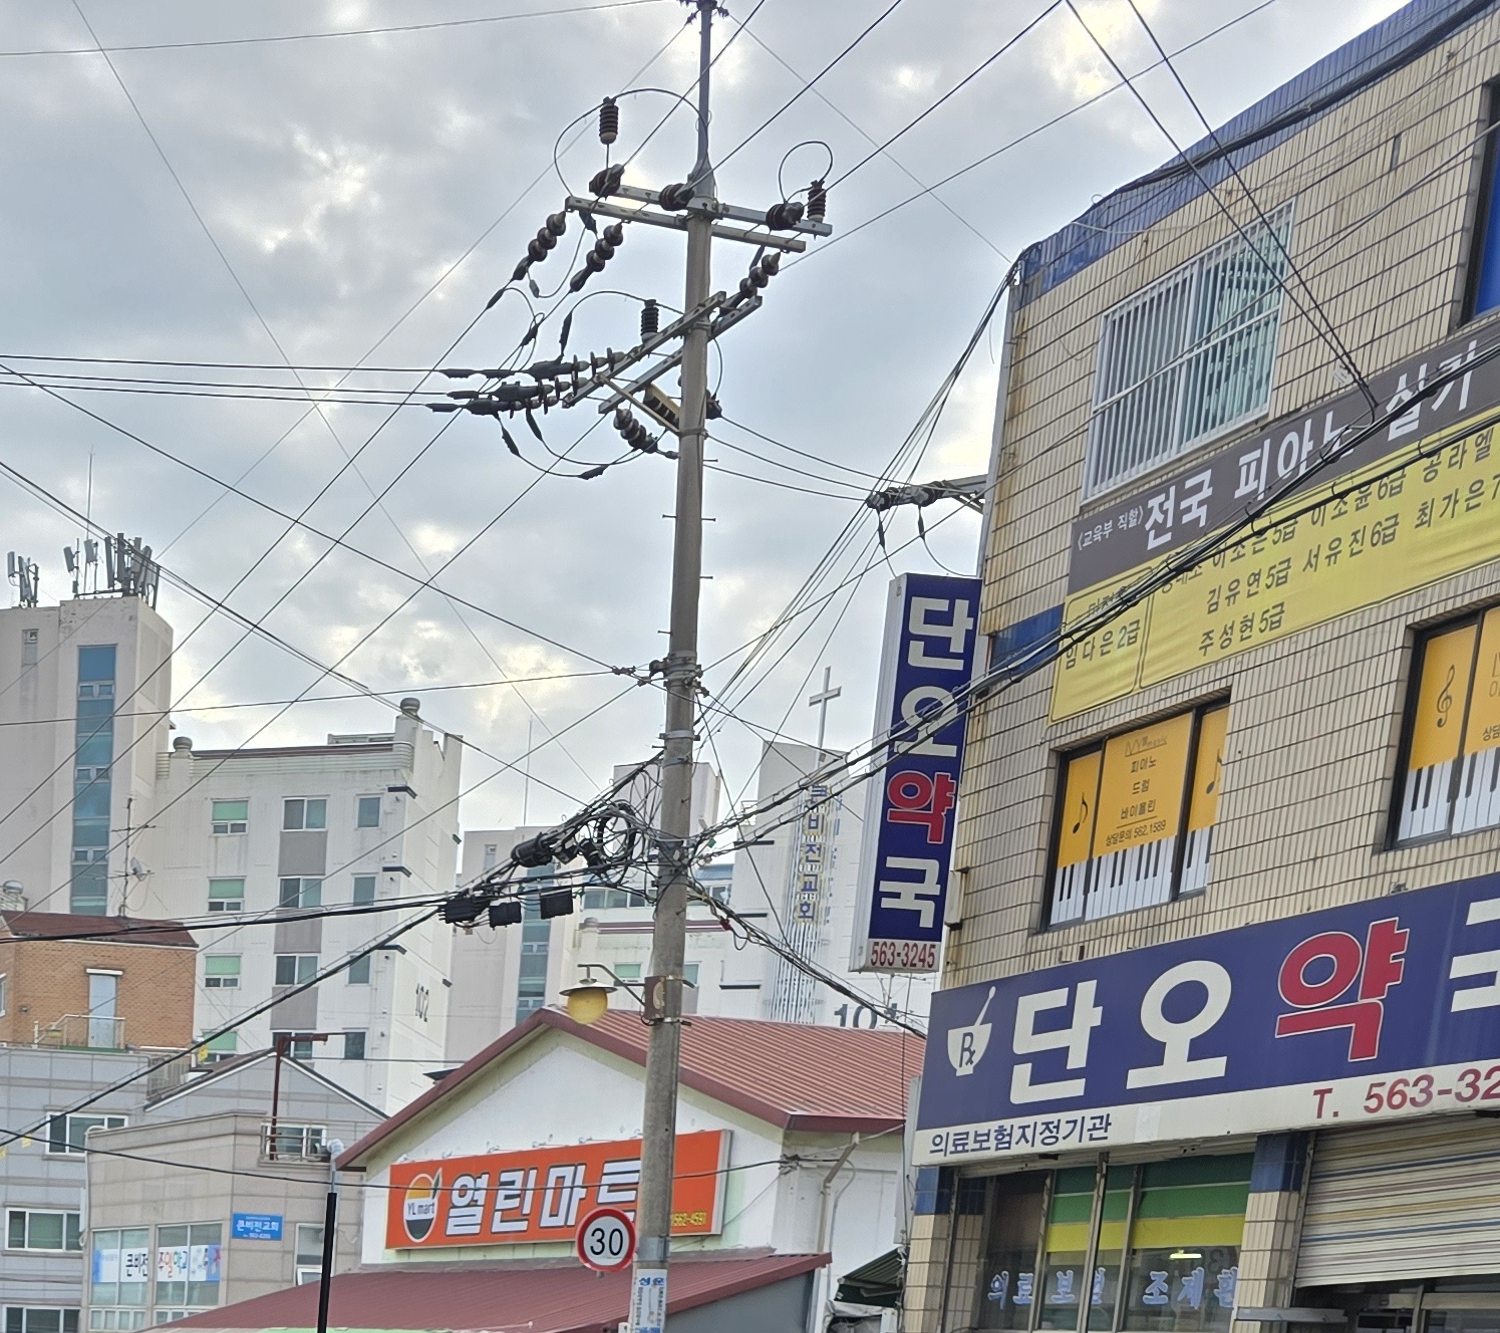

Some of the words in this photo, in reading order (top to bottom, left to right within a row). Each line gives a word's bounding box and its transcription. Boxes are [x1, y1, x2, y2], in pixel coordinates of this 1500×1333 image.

[1145, 469, 1213, 550] 전국
[1234, 411, 1354, 500] 피아노
[1385, 340, 1477, 441] 실기
[878, 596, 974, 928] 단오약국
[870, 940, 936, 969] 563-3245
[1312, 1087, 1339, 1119] T.
[929, 1113, 1112, 1158] 의료보험지정기관
[590, 1227, 624, 1256] 30
